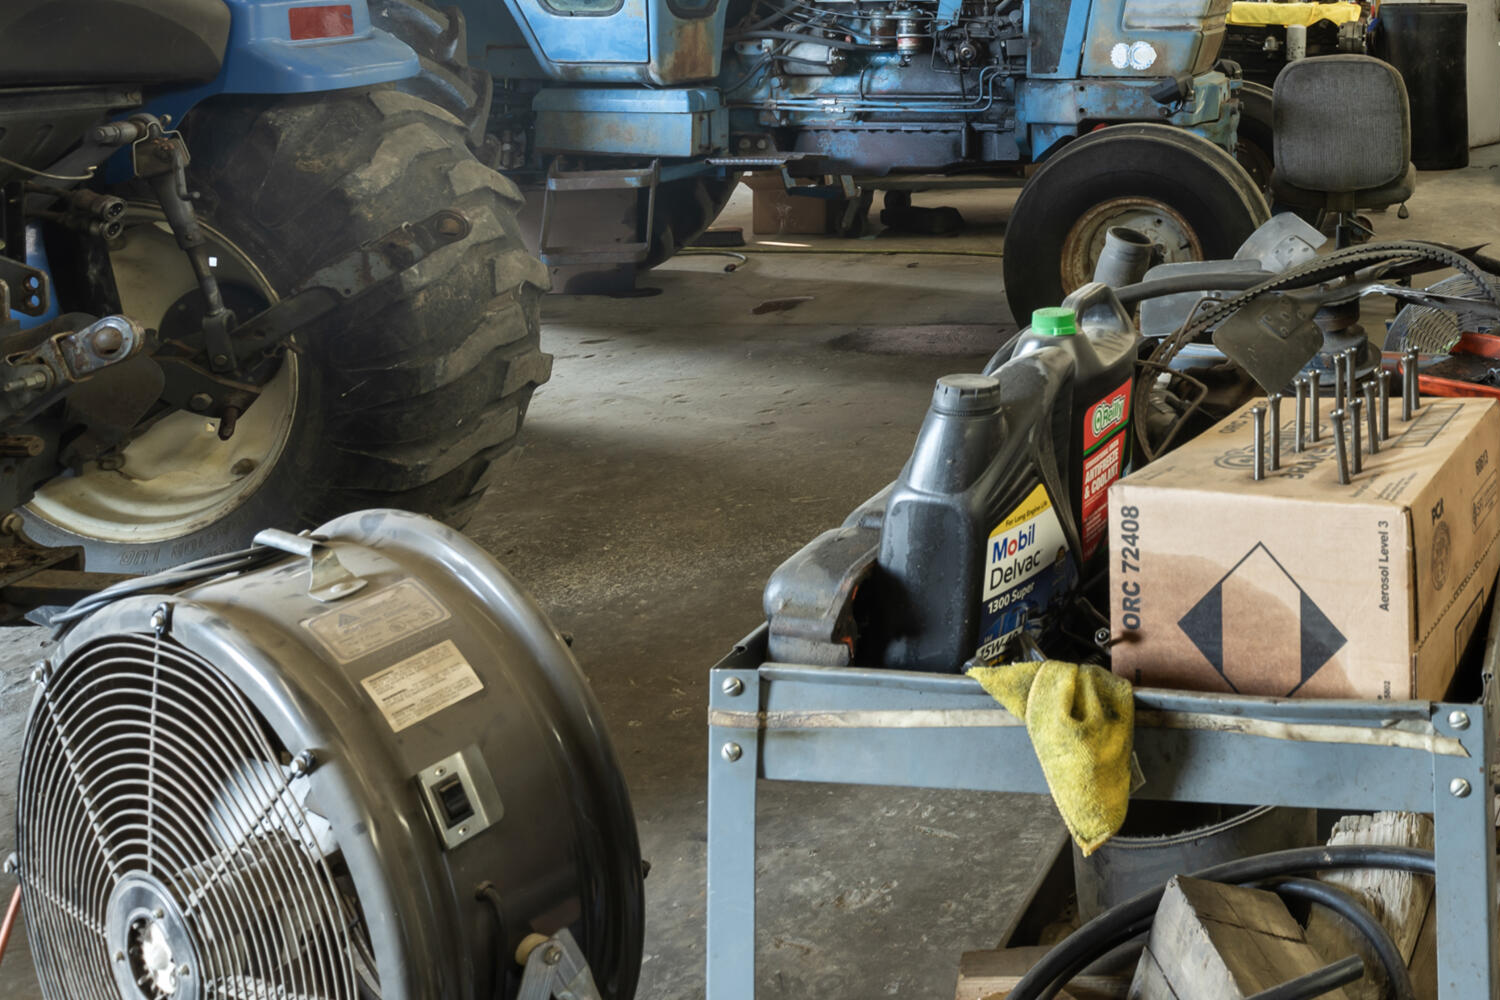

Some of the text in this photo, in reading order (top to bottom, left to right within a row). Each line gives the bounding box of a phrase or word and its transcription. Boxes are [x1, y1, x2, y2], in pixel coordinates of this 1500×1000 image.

[1091, 462, 1119, 494] COOLANT
[992, 523, 1036, 564] Mobil
[990, 550, 1042, 591] Delvac
[1120, 505, 1140, 631] ORC 72408
[1378, 520, 1390, 612] Aerosol Level 3
[987, 582, 1036, 615] 1300 Super
